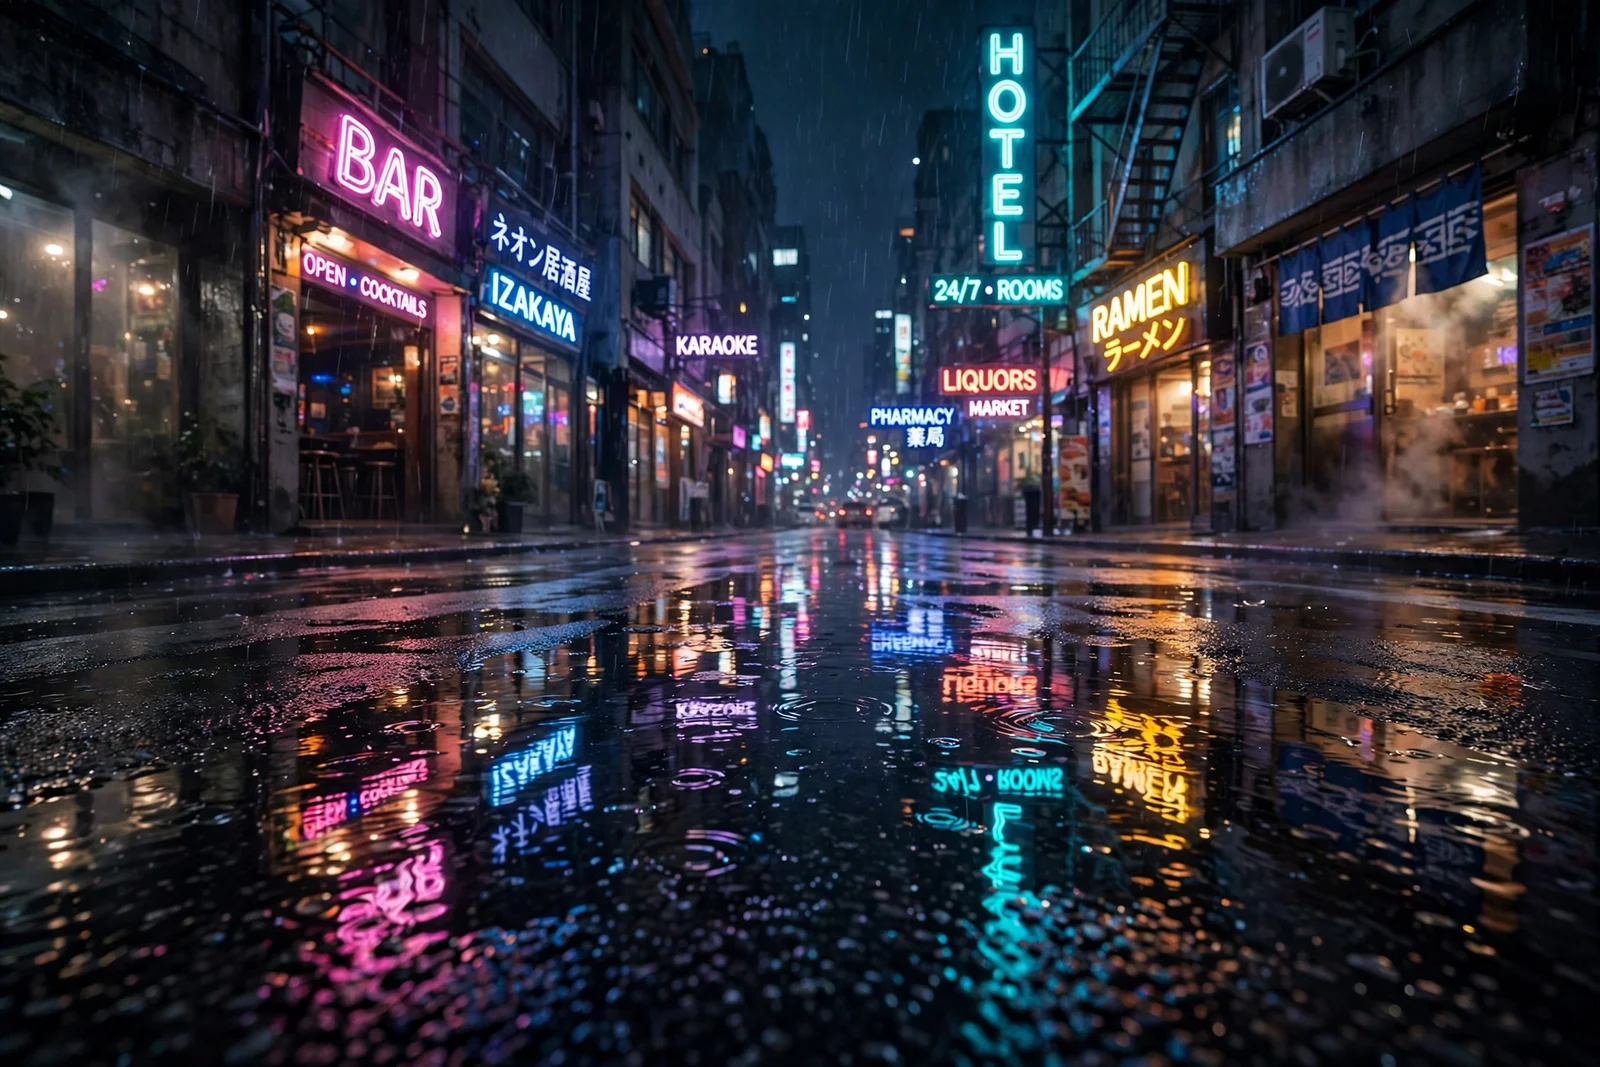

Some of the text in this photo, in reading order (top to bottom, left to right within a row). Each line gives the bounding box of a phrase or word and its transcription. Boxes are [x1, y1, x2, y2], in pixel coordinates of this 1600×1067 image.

[334, 113, 444, 239] BAR
[988, 32, 1027, 262] HOTEL
[303, 248, 428, 319] OPEN COCKTAILS
[490, 212, 592, 302] ネオン居酒屋
[491, 271, 577, 342] IZAKAYA
[934, 276, 1064, 304] 24/7 ROOMS
[1091, 260, 1189, 344] RAMEN
[675, 334, 758, 356] KARAOKE
[1103, 316, 1187, 373] ラーメン
[942, 368, 1038, 393] LIQUORS
[968, 399, 1030, 417] MARKET
[870, 407, 955, 426] PHARMACY
